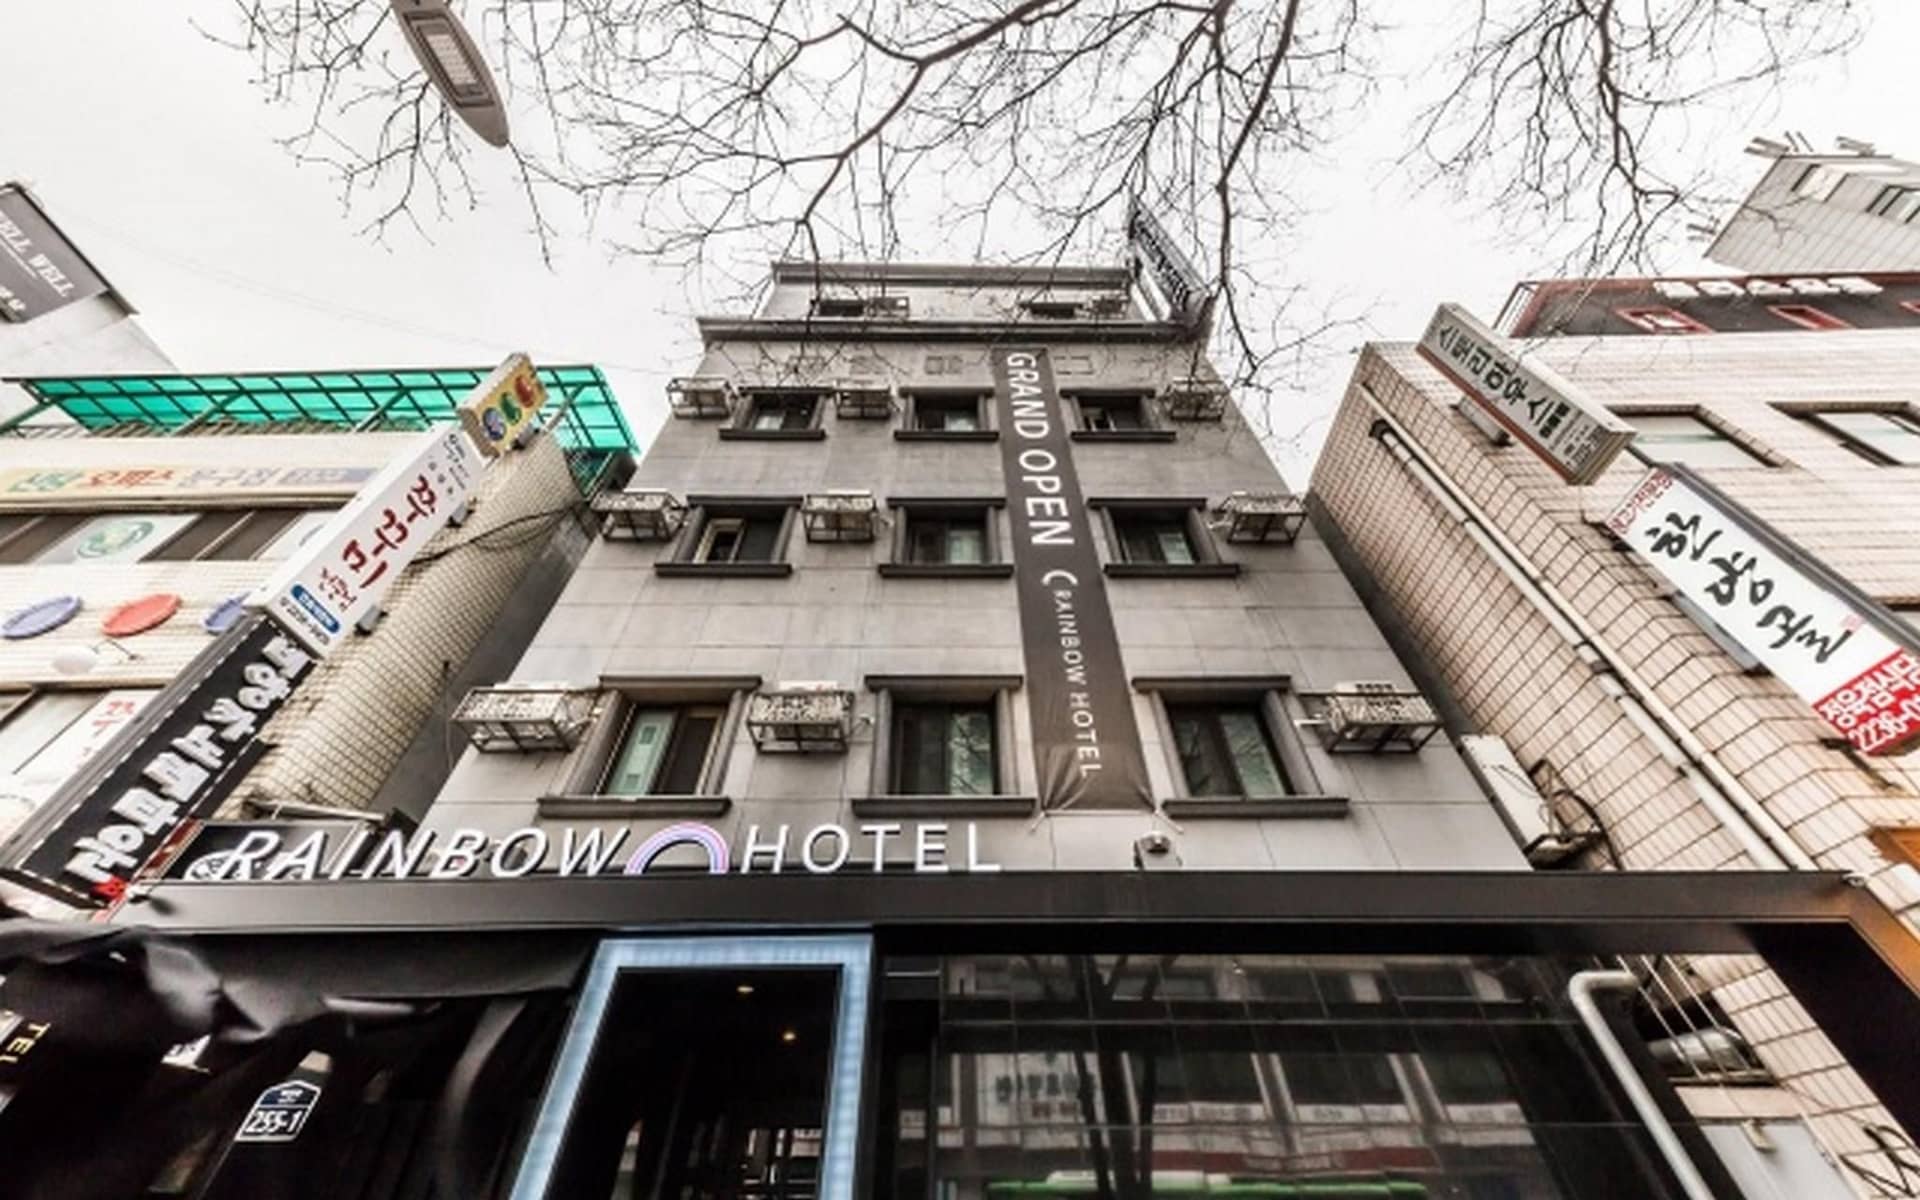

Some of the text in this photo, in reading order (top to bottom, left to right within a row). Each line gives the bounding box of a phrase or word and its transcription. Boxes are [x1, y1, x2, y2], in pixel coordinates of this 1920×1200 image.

[0, 209, 32, 252] ELL
[1006, 352, 1075, 546] GRAND OPEN
[342, 475, 438, 589] 쭈꾸미
[1053, 588, 1102, 778] RAINBOW HOTEL
[1848, 693, 1920, 752] 2236-0
[216, 825, 628, 880] RAINBOW
[739, 823, 1000, 874] HOTEL
[244, 1110, 303, 1133] 255-1
